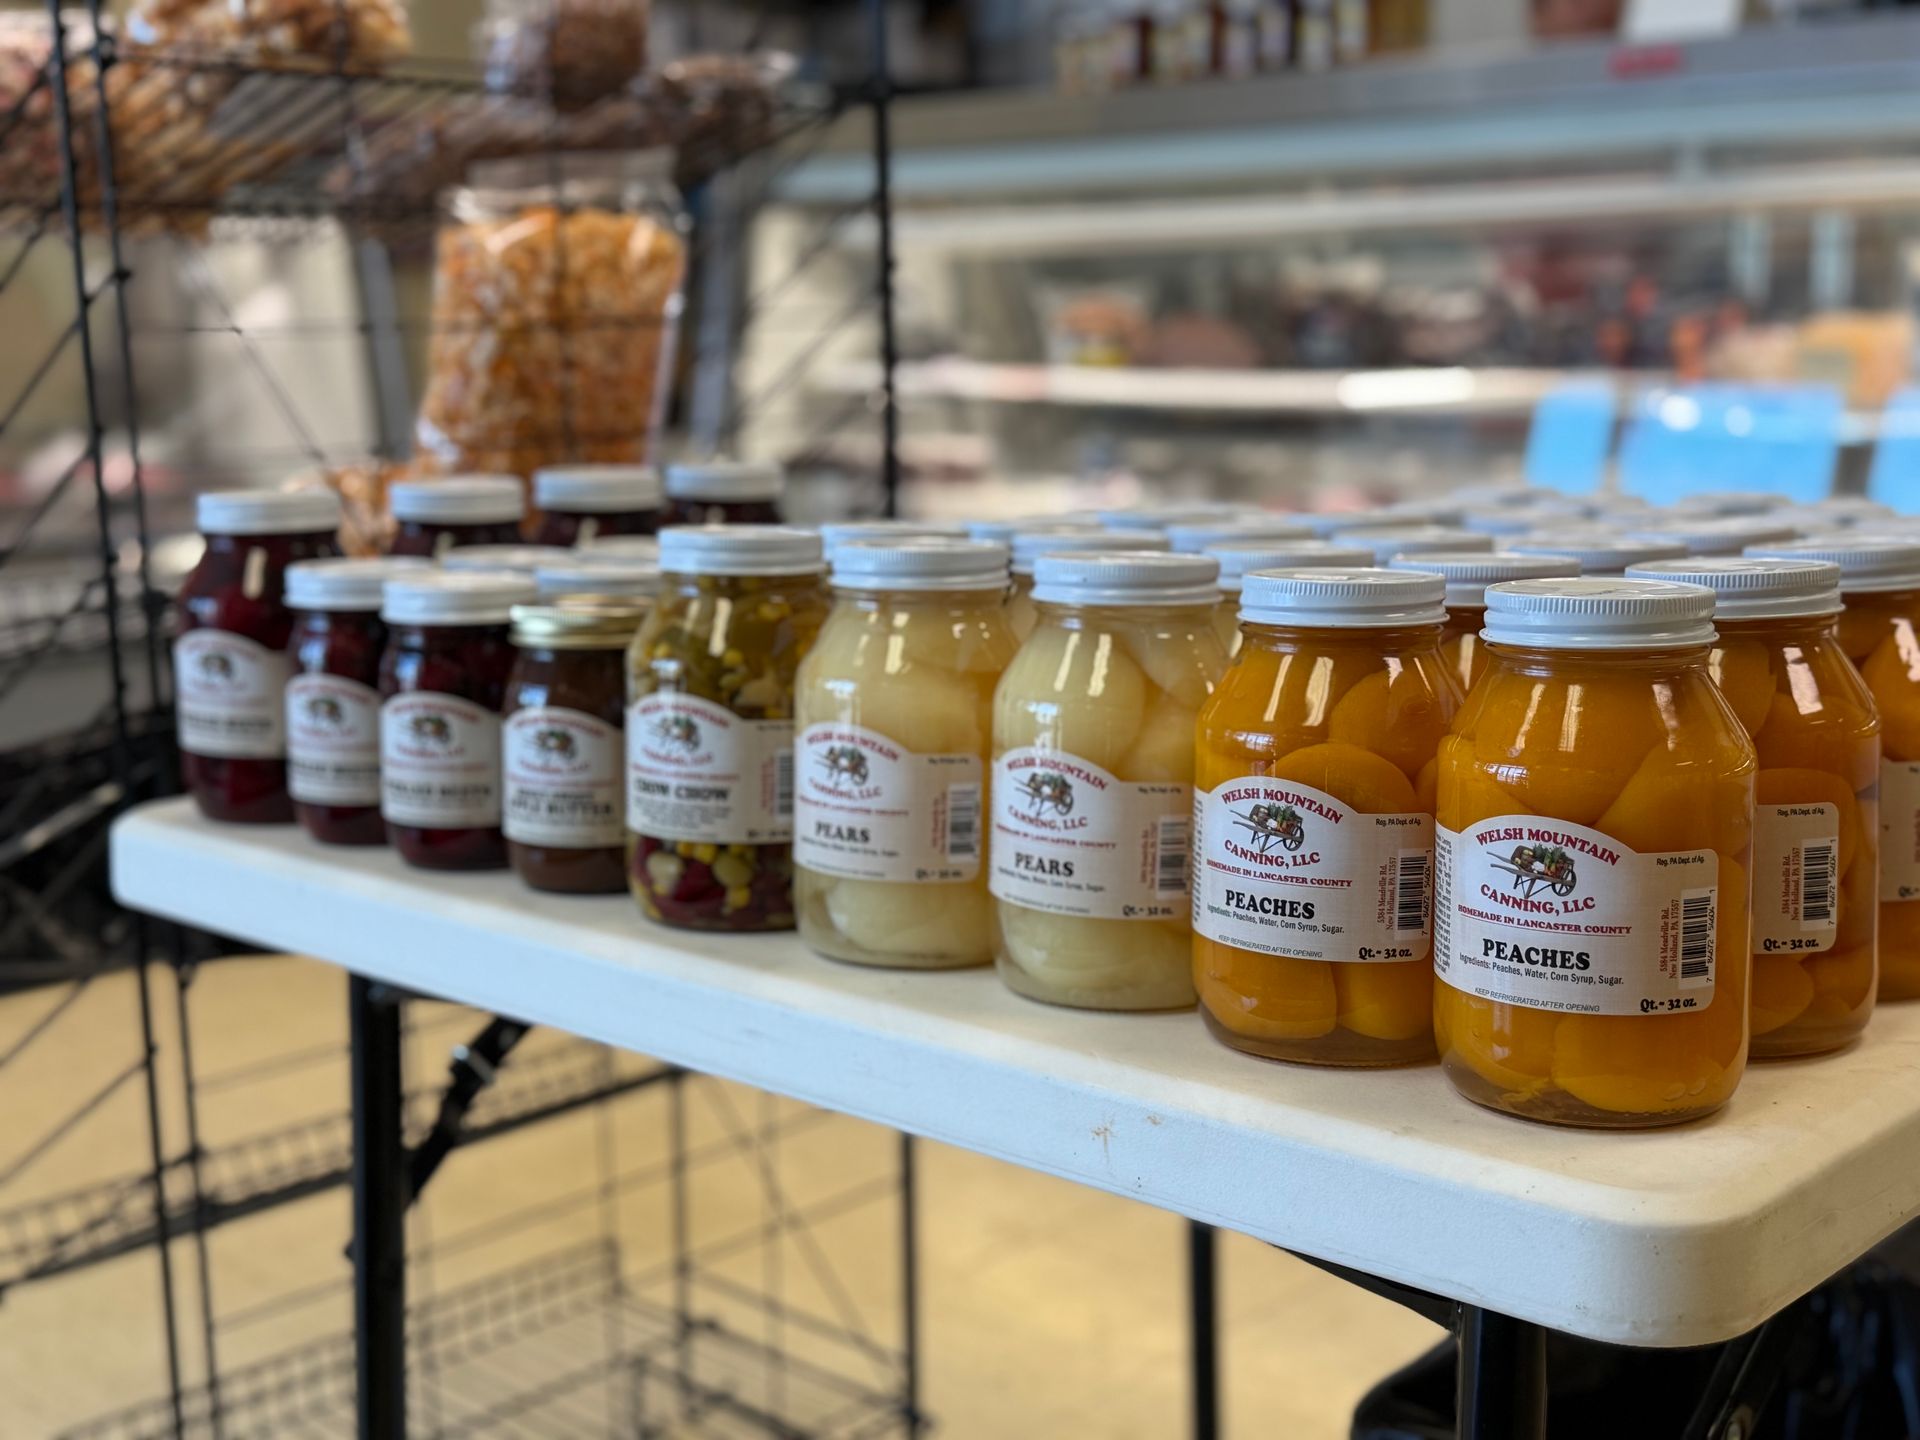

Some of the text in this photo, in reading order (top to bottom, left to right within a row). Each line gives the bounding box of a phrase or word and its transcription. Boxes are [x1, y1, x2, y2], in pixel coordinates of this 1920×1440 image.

[1039, 758, 1109, 791] MOUNTAIN
[1222, 787, 1344, 825] WELSH MOUNTAIN
[1811, 807, 1818, 815] of
[814, 821, 871, 844] PEARS
[1063, 816, 1088, 831] LLC
[1223, 839, 1321, 870] CANNING, LLC
[1475, 827, 1621, 866] WELSH MOUNTAIN
[1014, 852, 1075, 878] PEARS
[1206, 858, 1353, 888] HOMEMADE IN LANCASTER COUNTY
[1656, 857, 1668, 867] Reg.
[1669, 857, 1677, 865] PA
[1678, 857, 1691, 866] Dept.
[1782, 854, 1791, 867] Rd.
[1792, 868, 1800, 877] PA
[1388, 876, 1396, 886] PA
[1791, 878, 1800, 905] Holland,
[1225, 889, 1316, 920] PEACHES
[1386, 887, 1396, 914] Holland,
[1480, 884, 1596, 916] CANNING, LLC
[1232, 911, 1258, 925] Peaches,
[1258, 916, 1279, 929] Water,
[1280, 920, 1296, 930] Corn
[1297, 922, 1320, 933] Syrup,
[1321, 924, 1345, 935] Sugar.
[1385, 916, 1393, 930] New
[1457, 904, 1632, 934] HOMEMADE IN LANCASTER COUNTY
[1661, 907, 1670, 920] Rd.
[1660, 920, 1670, 955] Meadville
[1668, 899, 1680, 979] New Holland, PA 17557
[1789, 938, 1803, 949] 32
[1804, 939, 1819, 948] oz.
[1271, 945, 1292, 955] AFTER
[1292, 948, 1323, 959] OPENING
[1384, 946, 1397, 958] 32
[1398, 948, 1412, 957] oz.
[1482, 938, 1591, 970] PEACHES
[1459, 952, 1624, 987] Ingredients: Peaches, Water, Corn Syrup, Sugar.
[1474, 987, 1600, 1013] KEEP REFRIGERATED AFTER OPENING
[1667, 999, 1681, 1010] 32
[1682, 998, 1697, 1008] oz.
